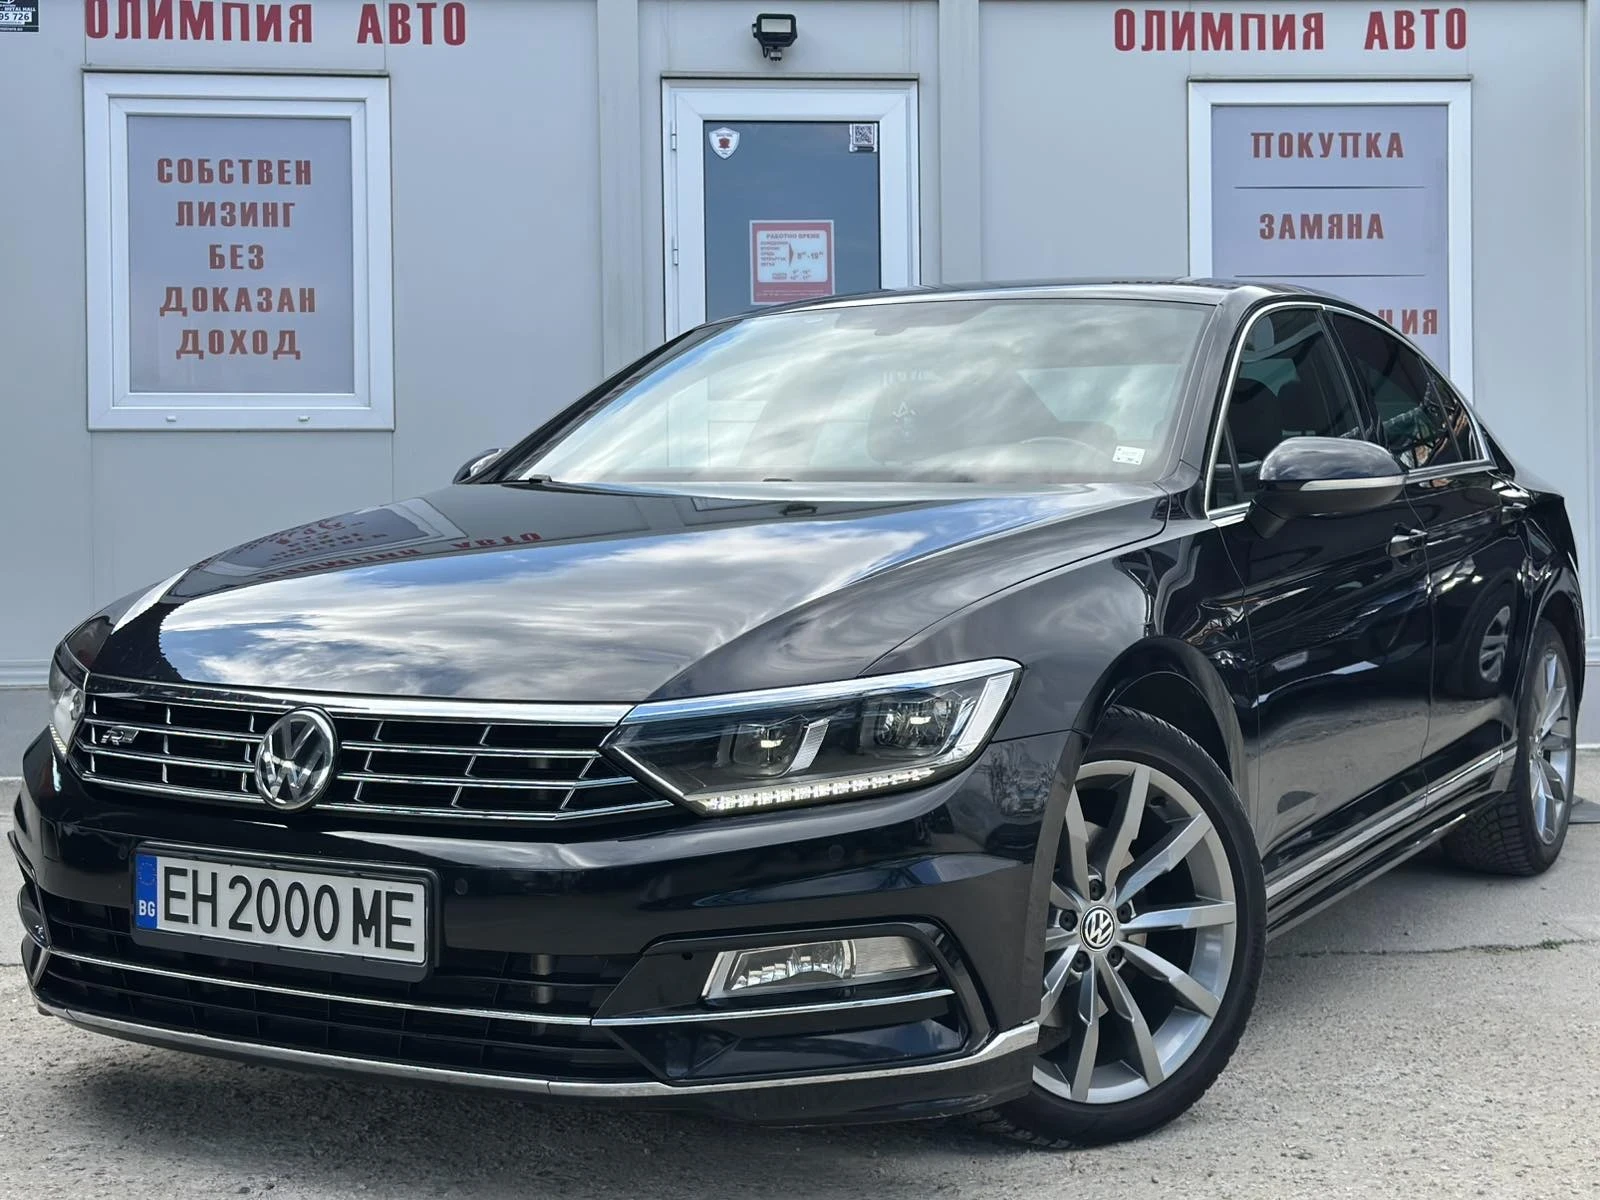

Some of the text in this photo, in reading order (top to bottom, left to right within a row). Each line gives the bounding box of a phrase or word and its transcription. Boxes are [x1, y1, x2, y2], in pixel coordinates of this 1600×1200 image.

[12, 12, 30, 21] 726
[85, 0, 467, 46] ОЛИМПИЯ АВТО
[1113, 7, 1468, 52] ОЛИМПИЯ АВТО
[1250, 131, 1405, 159] ПОКУПКА
[156, 157, 313, 186] СОБСТВЕН
[175, 200, 296, 228] ЛИЗИНГ
[1258, 212, 1385, 241] ЗАМЯНА
[208, 243, 265, 271] БЕЗ
[159, 285, 316, 318] ДОКАЗАН
[175, 328, 302, 361] ДОХОД
[256, 708, 335, 809] VW
[138, 899, 156, 918] BG
[163, 866, 416, 954] EH 2000 ME
[1083, 908, 1114, 949] VW
